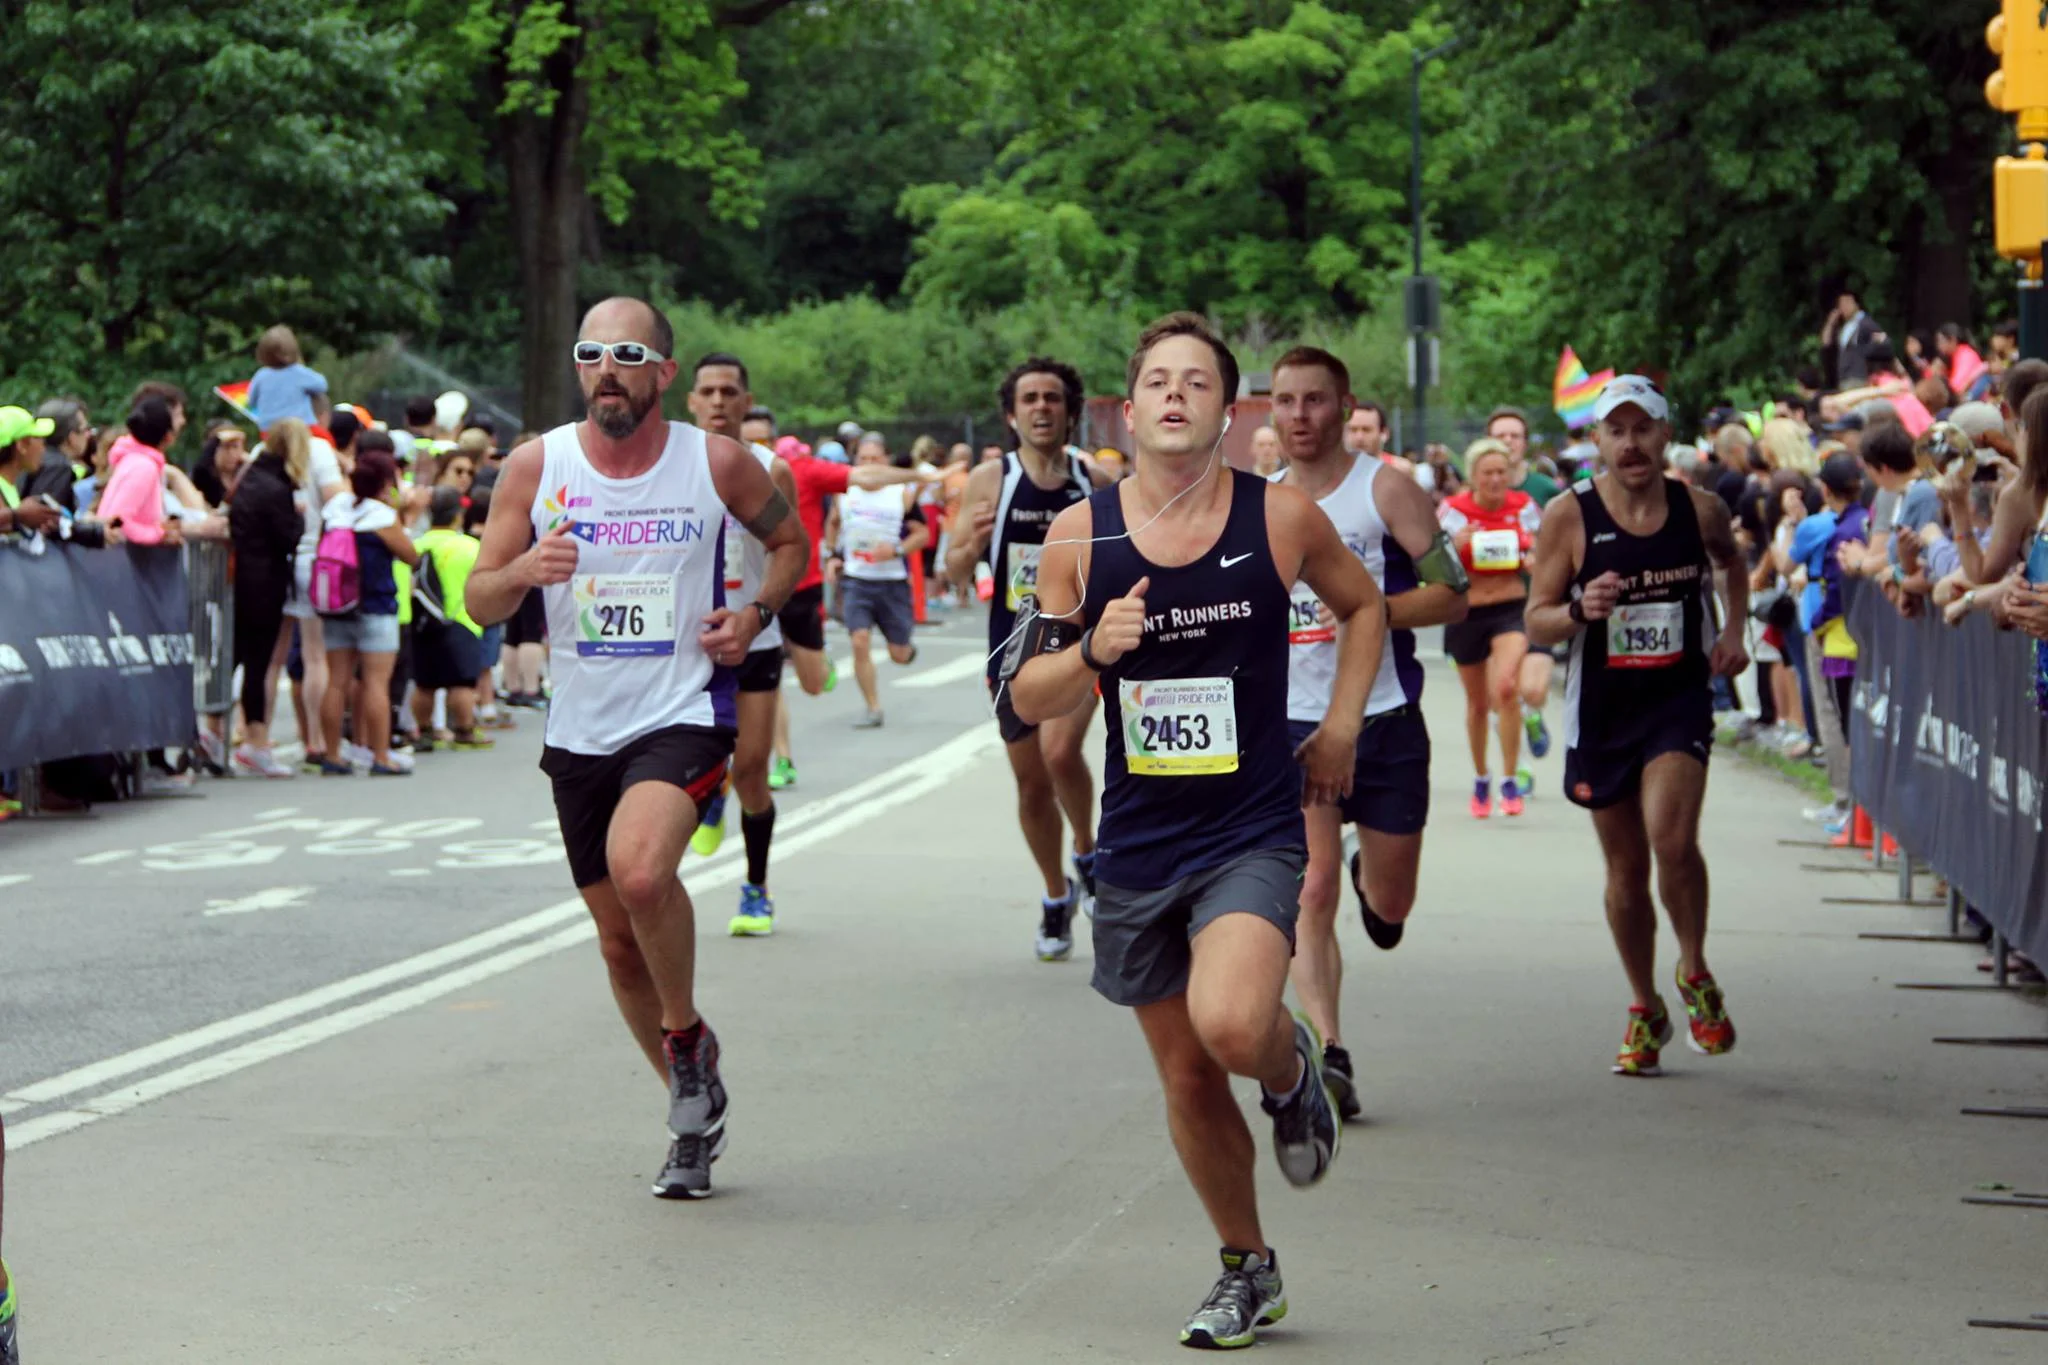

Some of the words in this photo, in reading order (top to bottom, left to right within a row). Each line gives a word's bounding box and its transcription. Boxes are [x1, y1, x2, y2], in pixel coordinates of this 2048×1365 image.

[600, 604, 645, 637] 276
[1171, 601, 1252, 628] RUNNERS
[1159, 632, 1180, 642] NEW
[1181, 628, 1207, 639] YORK
[1624, 626, 1670, 651] 1334
[1178, 693, 1203, 704] PRIDE
[1206, 693, 1227, 703] RUN
[1140, 713, 1211, 752] 2453
